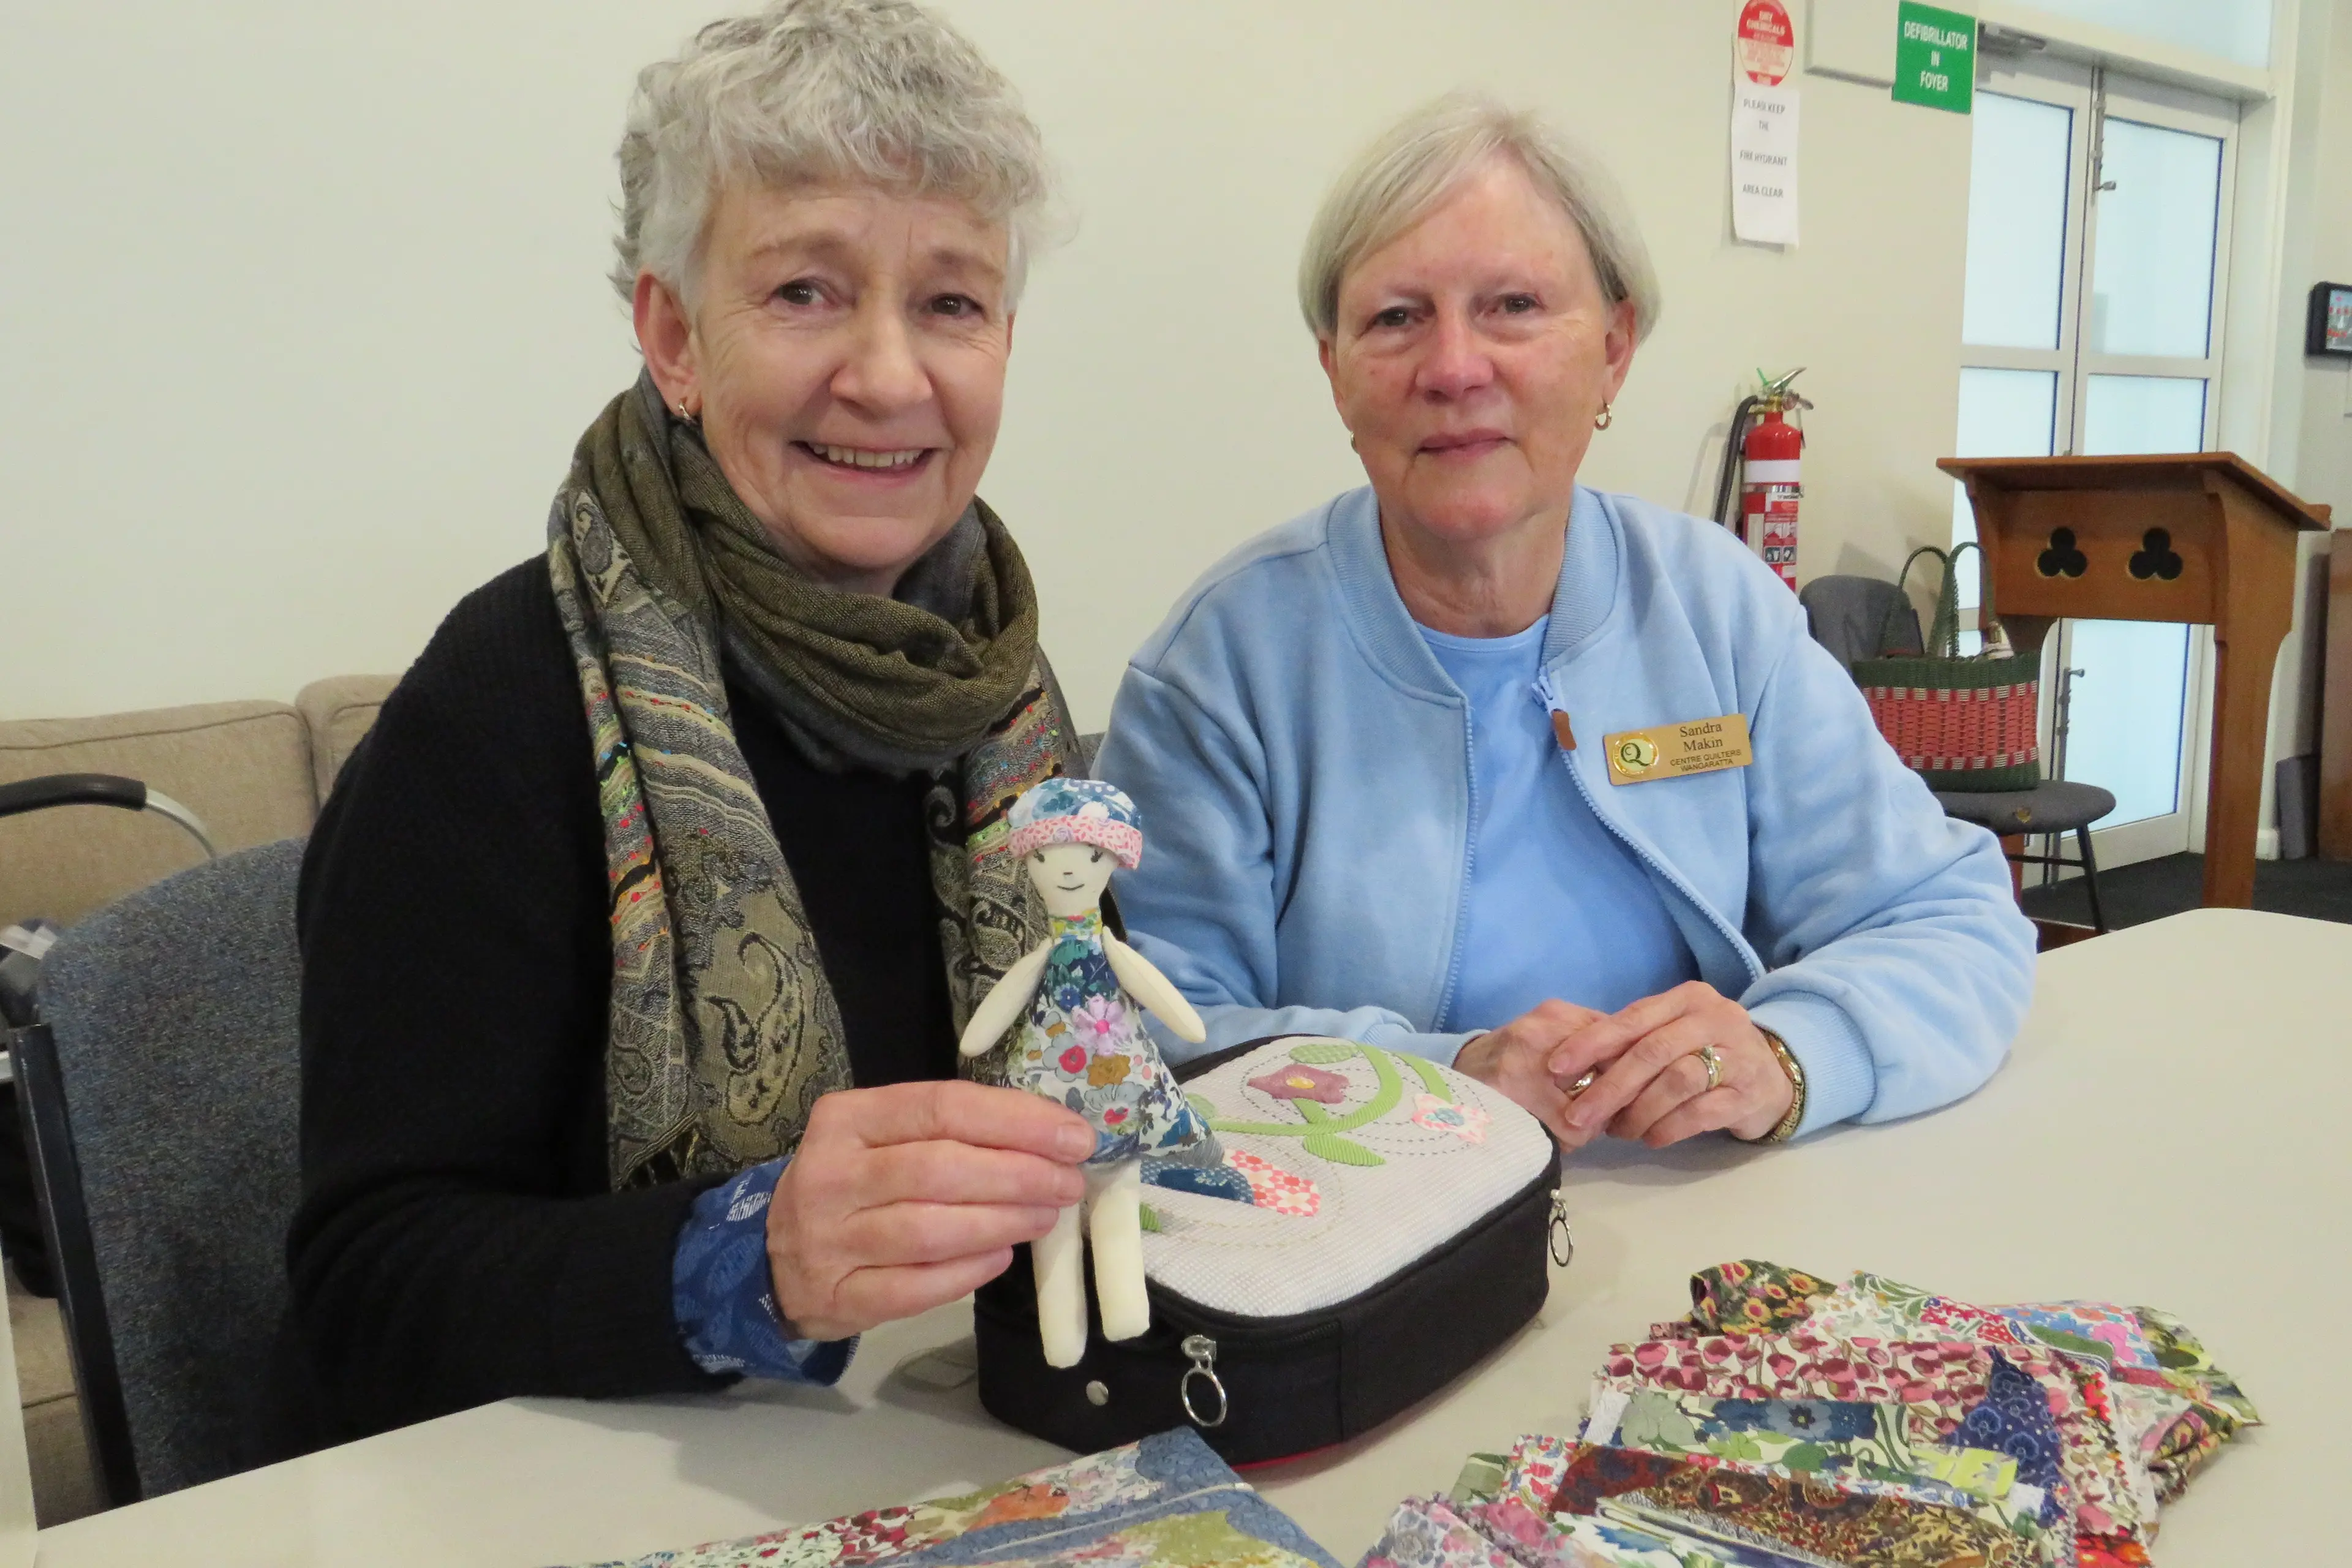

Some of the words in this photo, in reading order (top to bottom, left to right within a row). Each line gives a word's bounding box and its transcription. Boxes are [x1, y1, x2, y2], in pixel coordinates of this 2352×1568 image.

[1904, 20, 1968, 50] DEFIBRILLATOR
[1931, 50, 1940, 67] IN
[1920, 70, 1948, 92] FOYER
[1743, 98, 1766, 111] PLEASE
[1768, 102, 1785, 114] KEEP
[1758, 119, 1770, 132] THE
[1740, 149, 1754, 160] FIRE
[1754, 153, 1788, 167] HYDRANT
[1743, 183, 1760, 195] AREA
[1761, 186, 1784, 198] CLEAR
[1679, 722, 1722, 737] Sandra
[1683, 737, 1723, 753] Makin
[1670, 755, 1702, 766] CENTRE
[1703, 749, 1742, 761] QUILTERS
[1680, 758, 1734, 772] WANGARATTA
